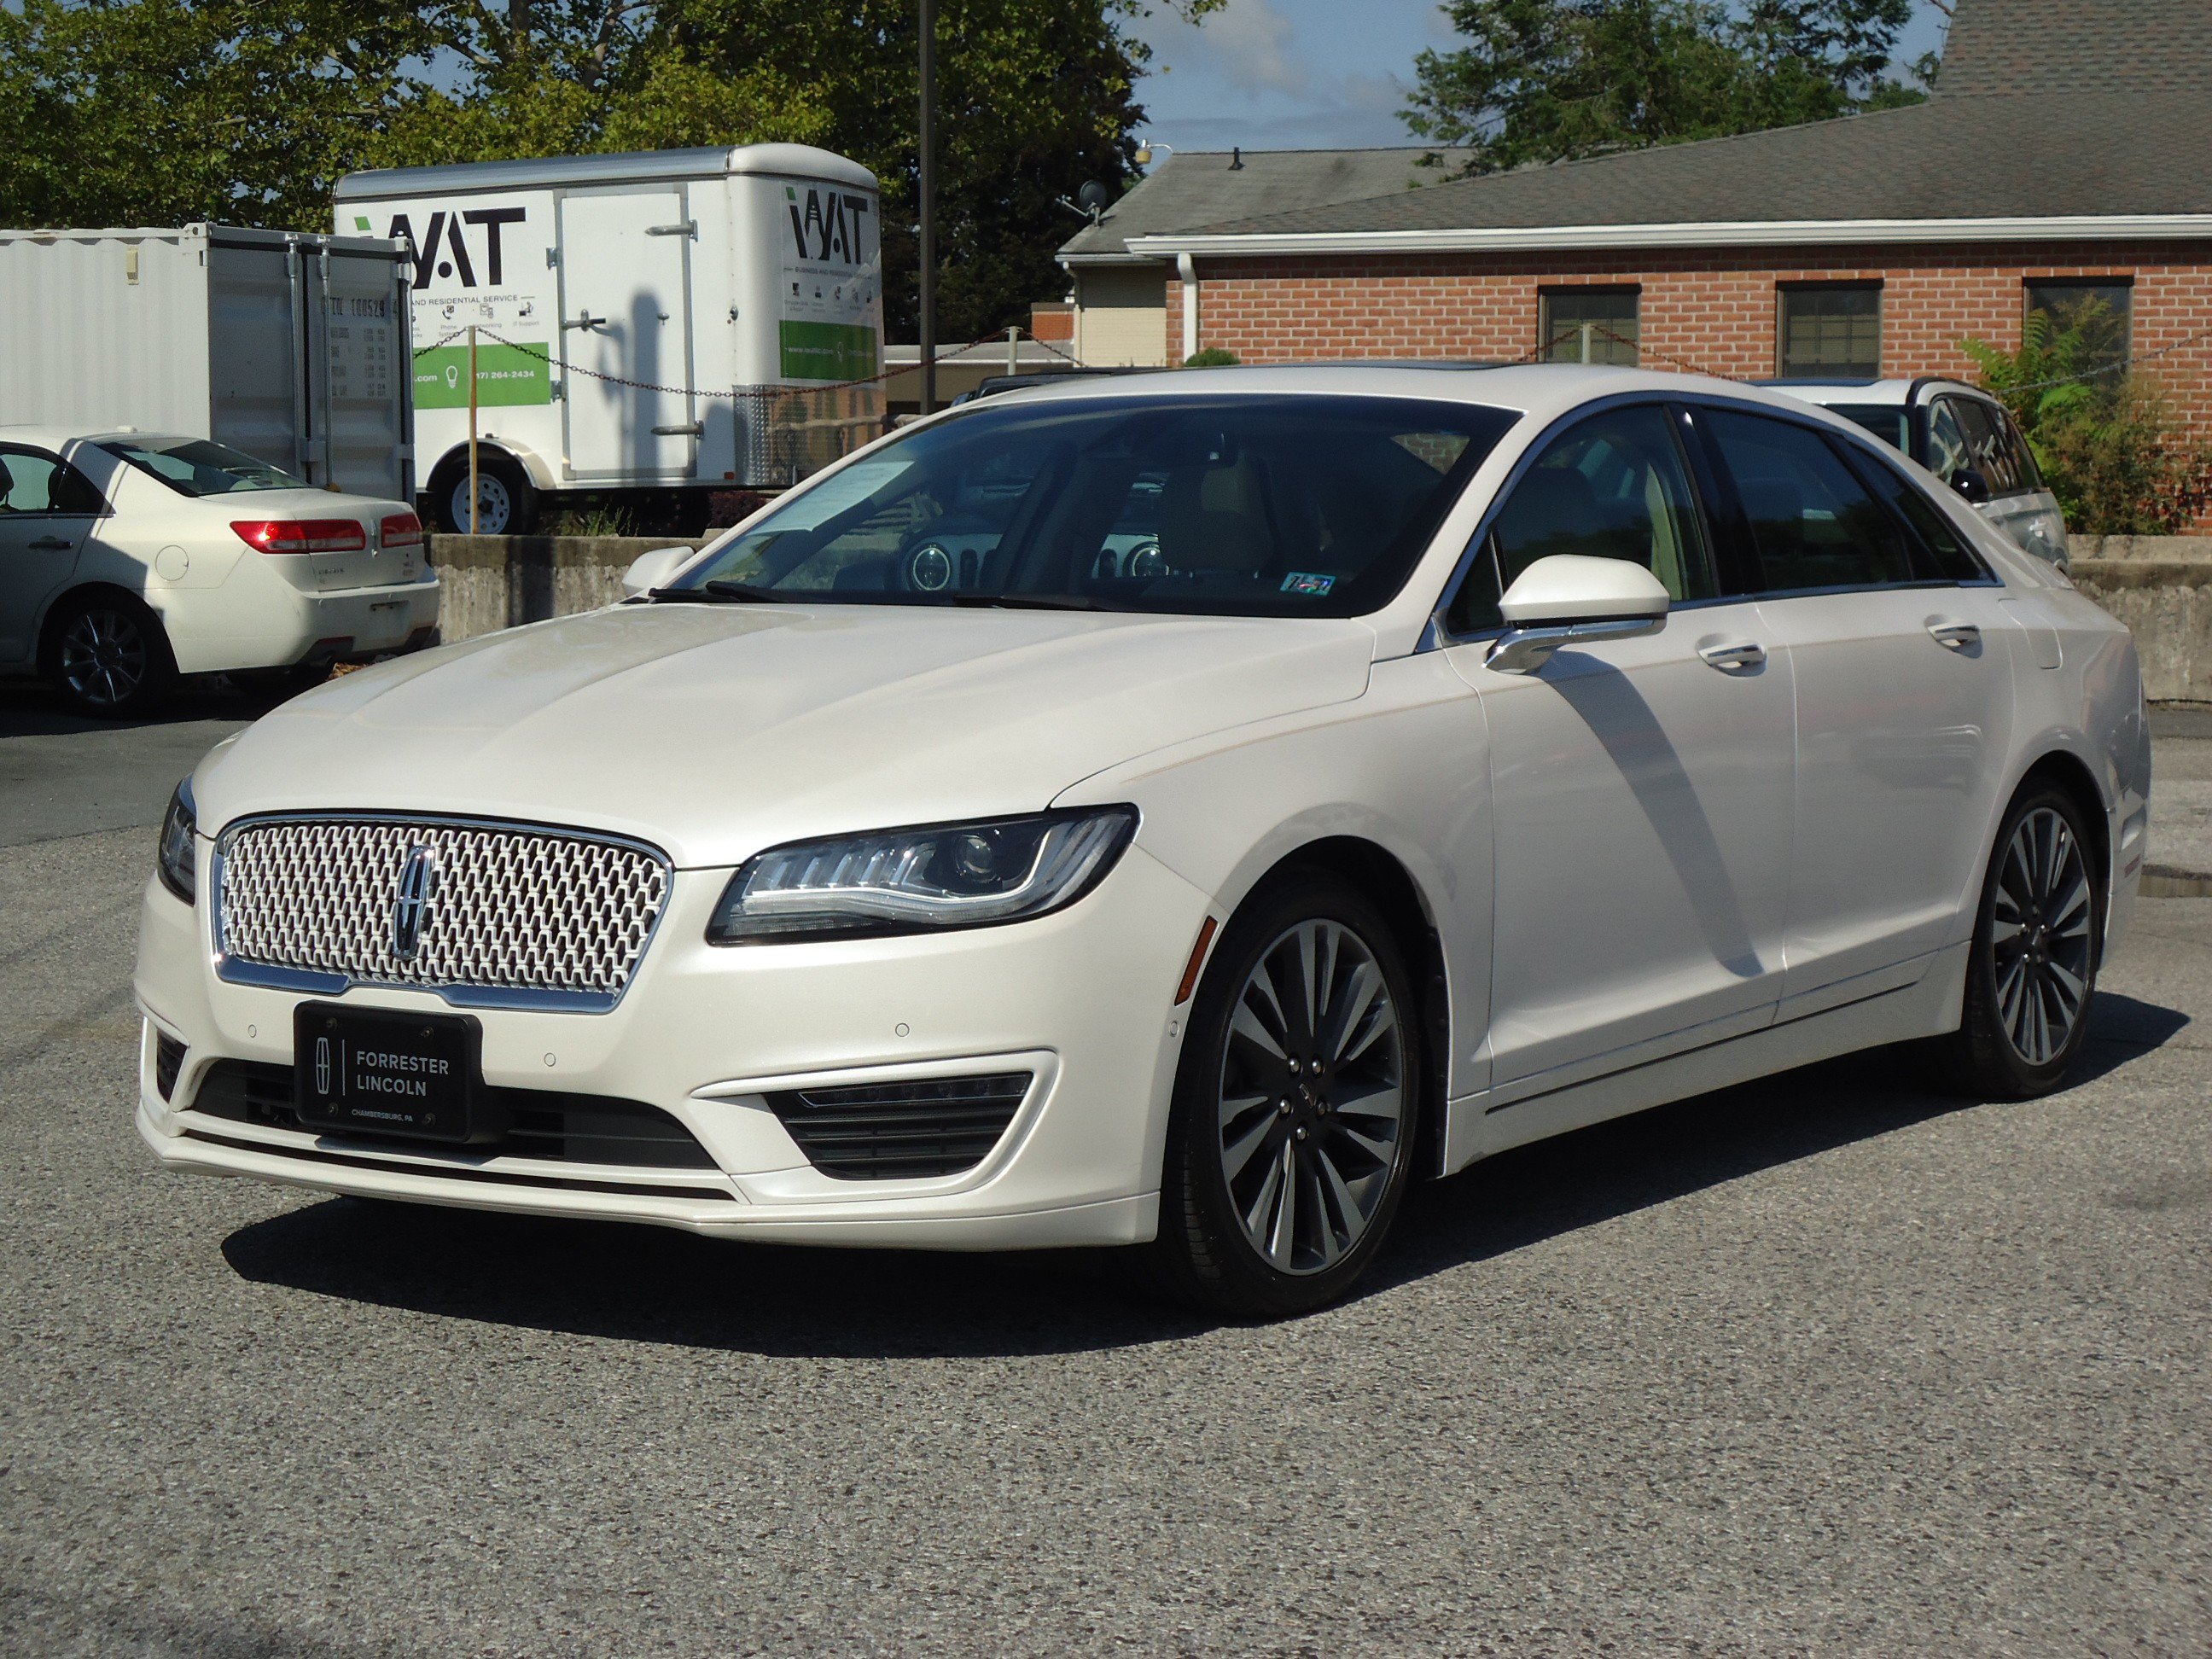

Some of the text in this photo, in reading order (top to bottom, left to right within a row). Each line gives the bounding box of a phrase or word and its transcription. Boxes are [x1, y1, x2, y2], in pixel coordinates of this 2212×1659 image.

[428, 296, 480, 306] RESIDENTIAL
[483, 294, 518, 303] SERVICE
[491, 370, 535, 379] 264-2434
[357, 1051, 449, 1074] FORRESTER
[357, 1074, 426, 1096] LINCOLN
